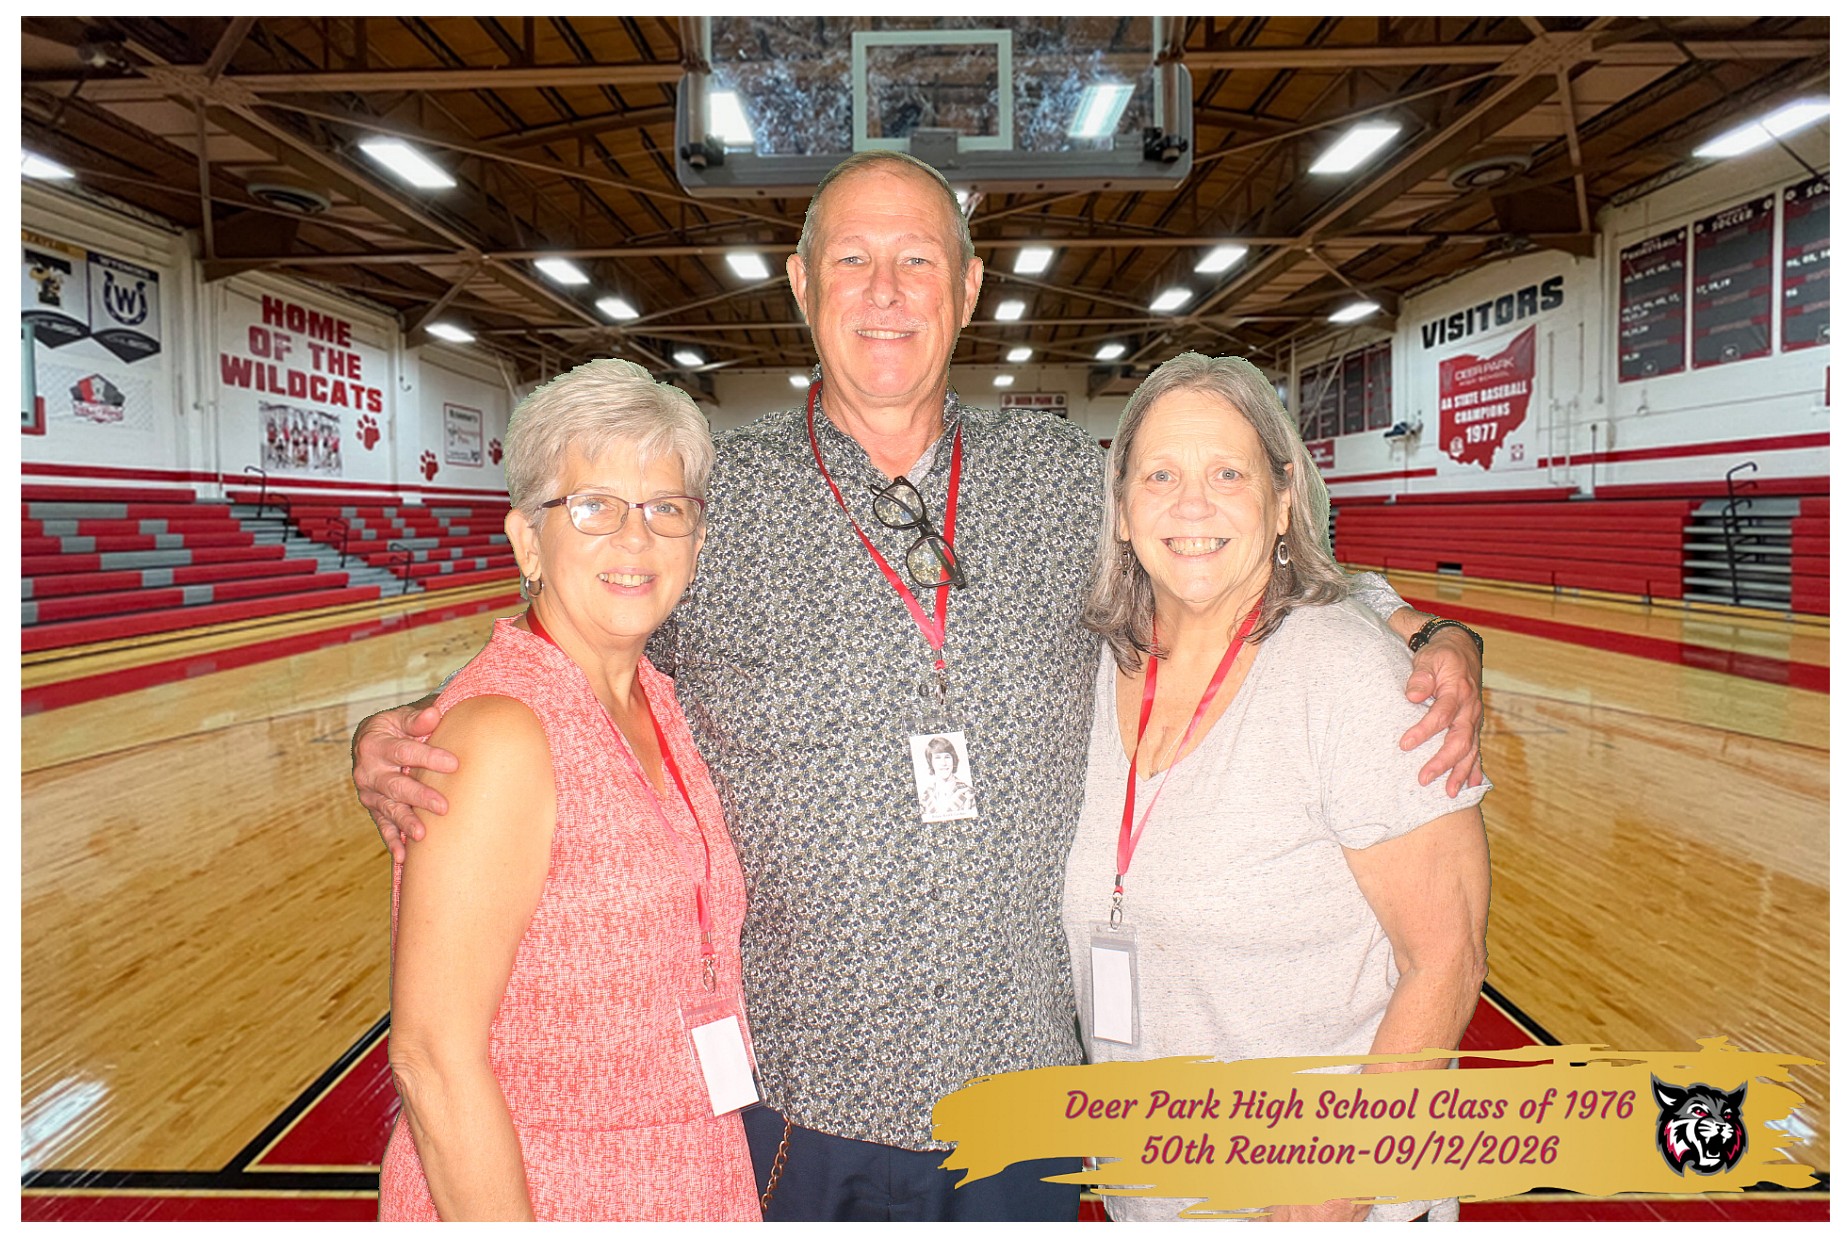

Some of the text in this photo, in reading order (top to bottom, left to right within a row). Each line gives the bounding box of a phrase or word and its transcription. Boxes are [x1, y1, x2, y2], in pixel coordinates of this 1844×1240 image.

[1712, 209, 1753, 232] SOCCER
[114, 284, 137, 315] W
[1421, 275, 1564, 349] VISITORS
[261, 294, 352, 348] HOME
[248, 325, 361, 381] OF THE
[220, 353, 383, 413] WILDCATS
[1455, 356, 1514, 381] DEER PARK
[1441, 380, 1528, 410] AA STATE BASEBALL
[1454, 402, 1511, 424] CHAMPIONS
[1465, 421, 1498, 444] 1977
